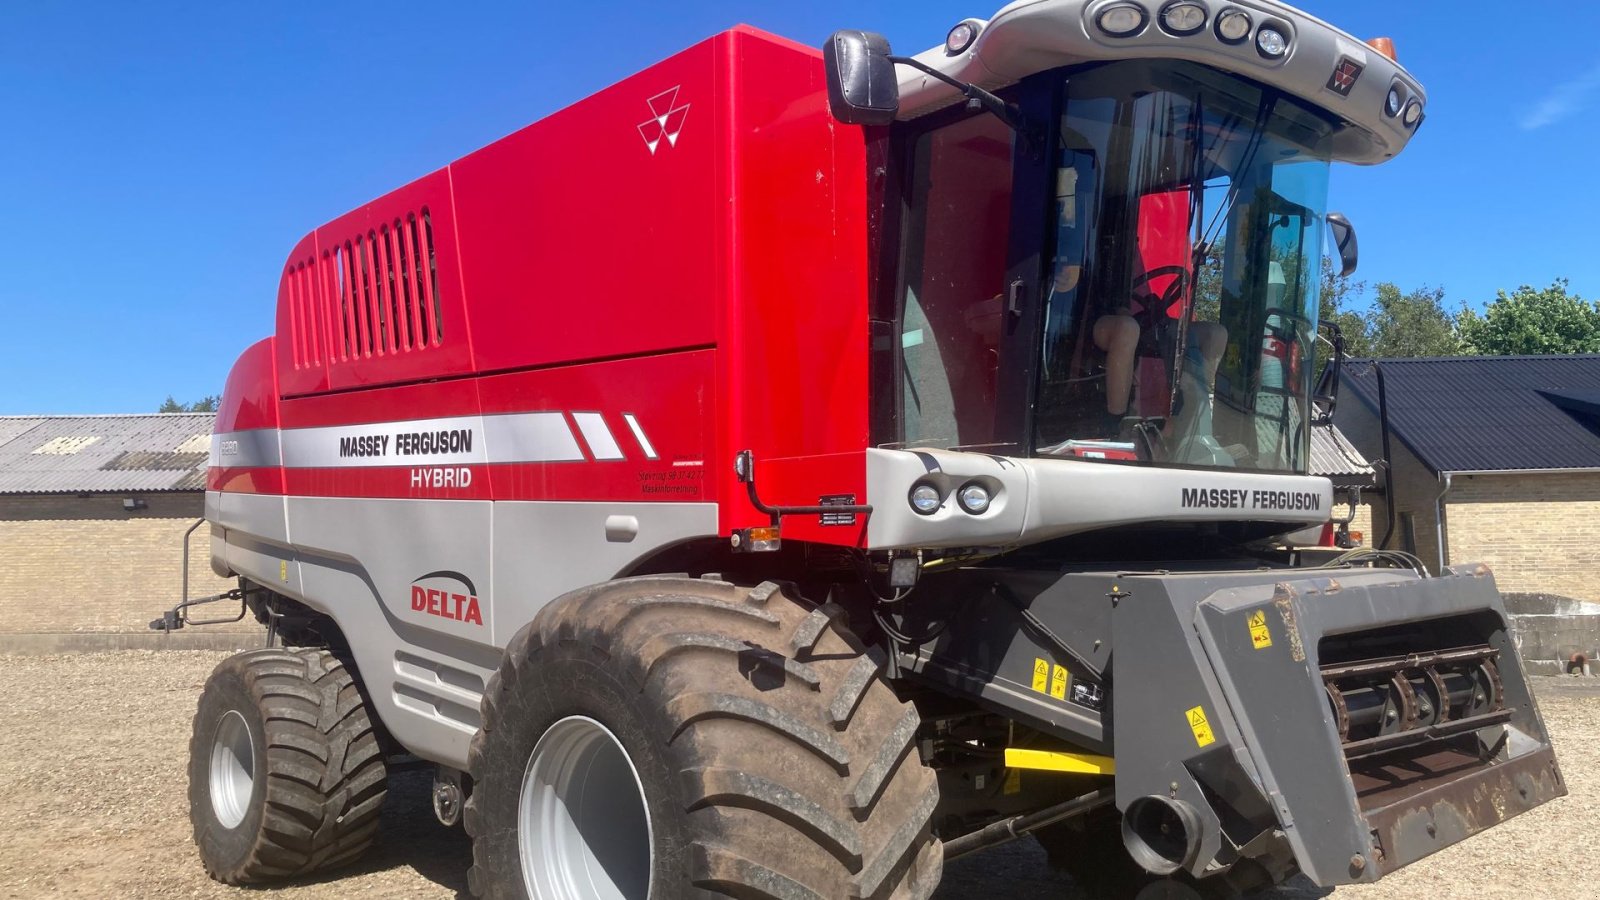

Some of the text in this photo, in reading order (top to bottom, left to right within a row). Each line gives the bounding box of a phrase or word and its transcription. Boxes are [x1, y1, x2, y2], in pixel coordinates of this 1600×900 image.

[340, 429, 472, 457] MASSEY FERGUSON
[411, 467, 472, 488] HYBRID
[1181, 488, 1320, 511] MASSEY FERGUSON
[411, 585, 483, 626] DELTA
